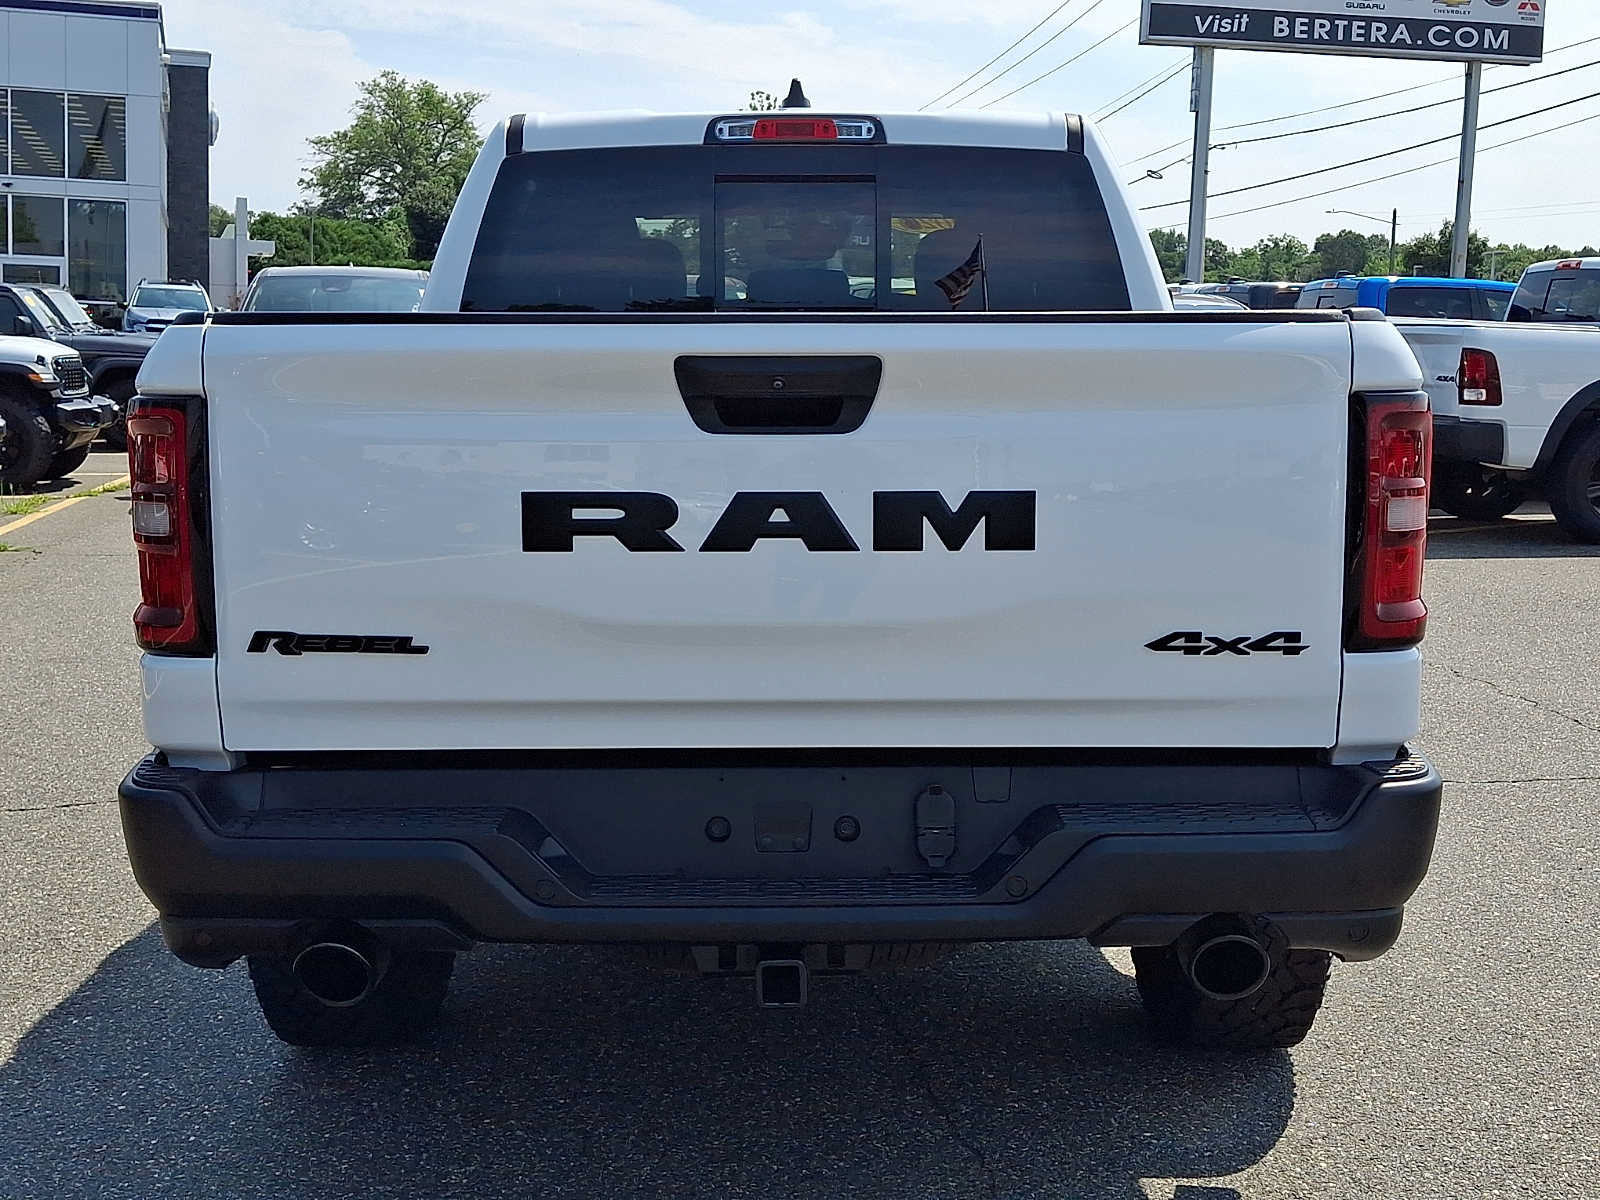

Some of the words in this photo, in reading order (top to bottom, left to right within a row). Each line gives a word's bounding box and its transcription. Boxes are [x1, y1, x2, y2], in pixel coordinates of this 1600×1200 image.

[1345, 2, 1386, 10] SUBARU
[1195, 14, 1250, 34] Visit
[1272, 17, 1509, 50] BERTERA.COM
[521, 491, 1036, 552] RAM
[1144, 632, 1310, 655] 4x4
